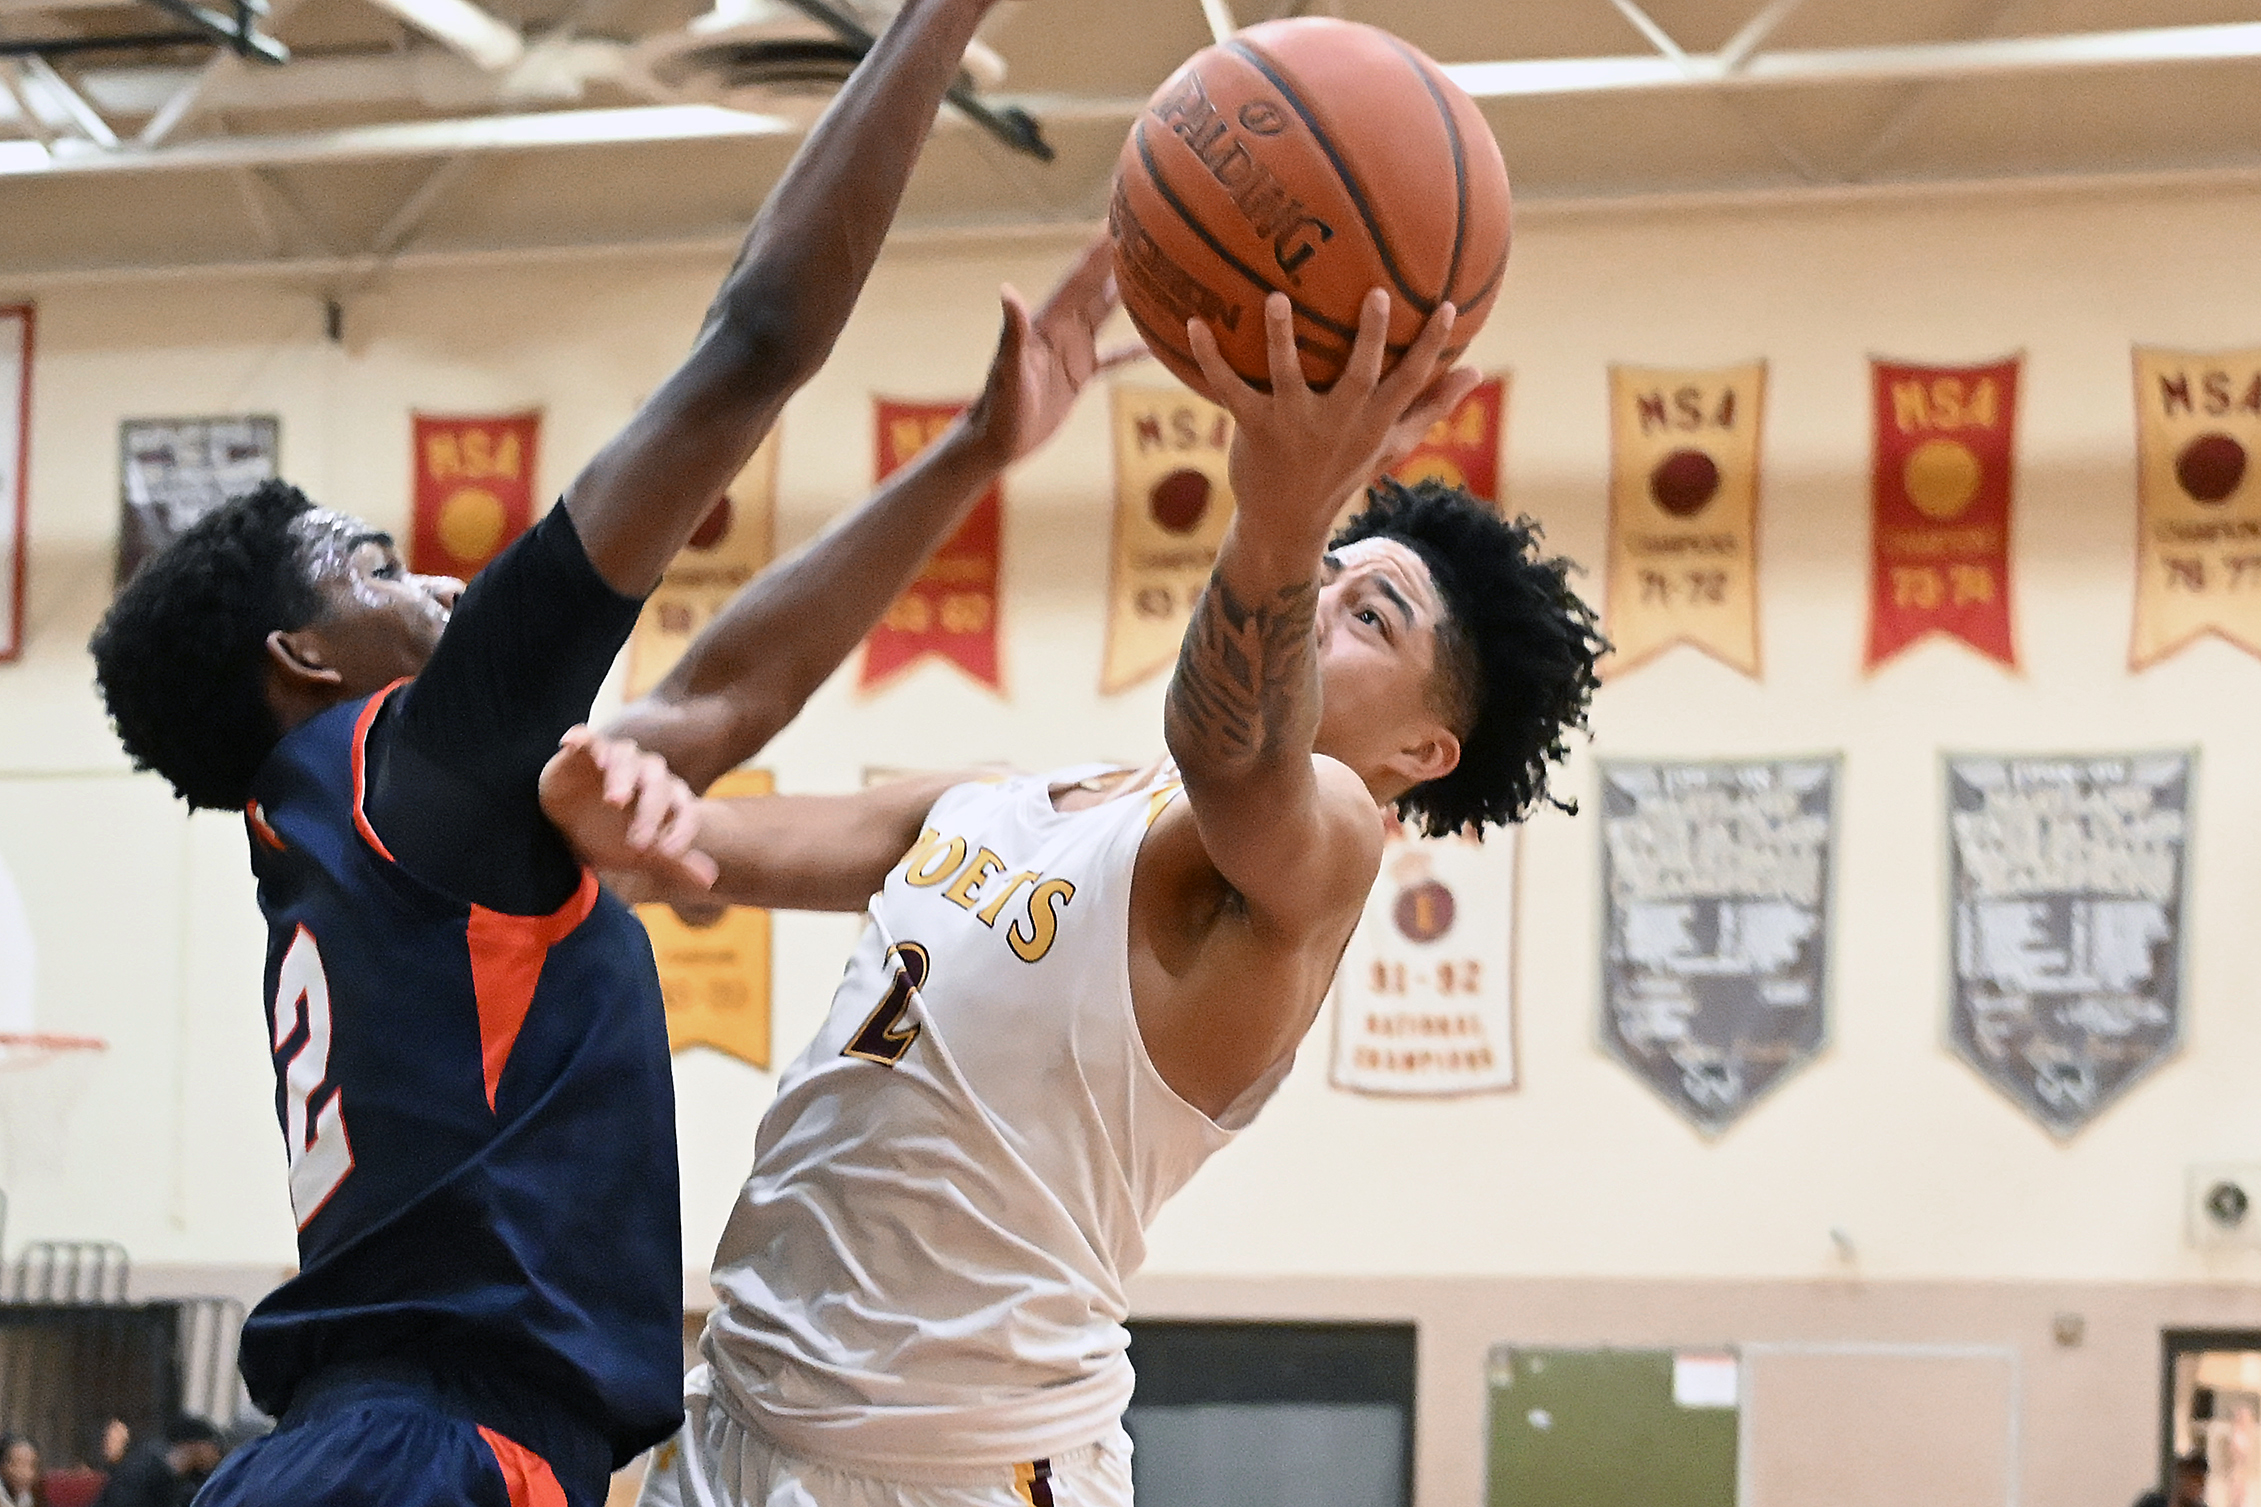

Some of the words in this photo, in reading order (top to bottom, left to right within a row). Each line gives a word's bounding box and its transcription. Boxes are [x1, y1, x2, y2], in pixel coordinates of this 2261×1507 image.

[1635, 386, 1738, 435] MSA
[1891, 375, 1998, 433] MSA
[840, 940, 931, 1068] 2
[274, 922, 356, 1233] 2
